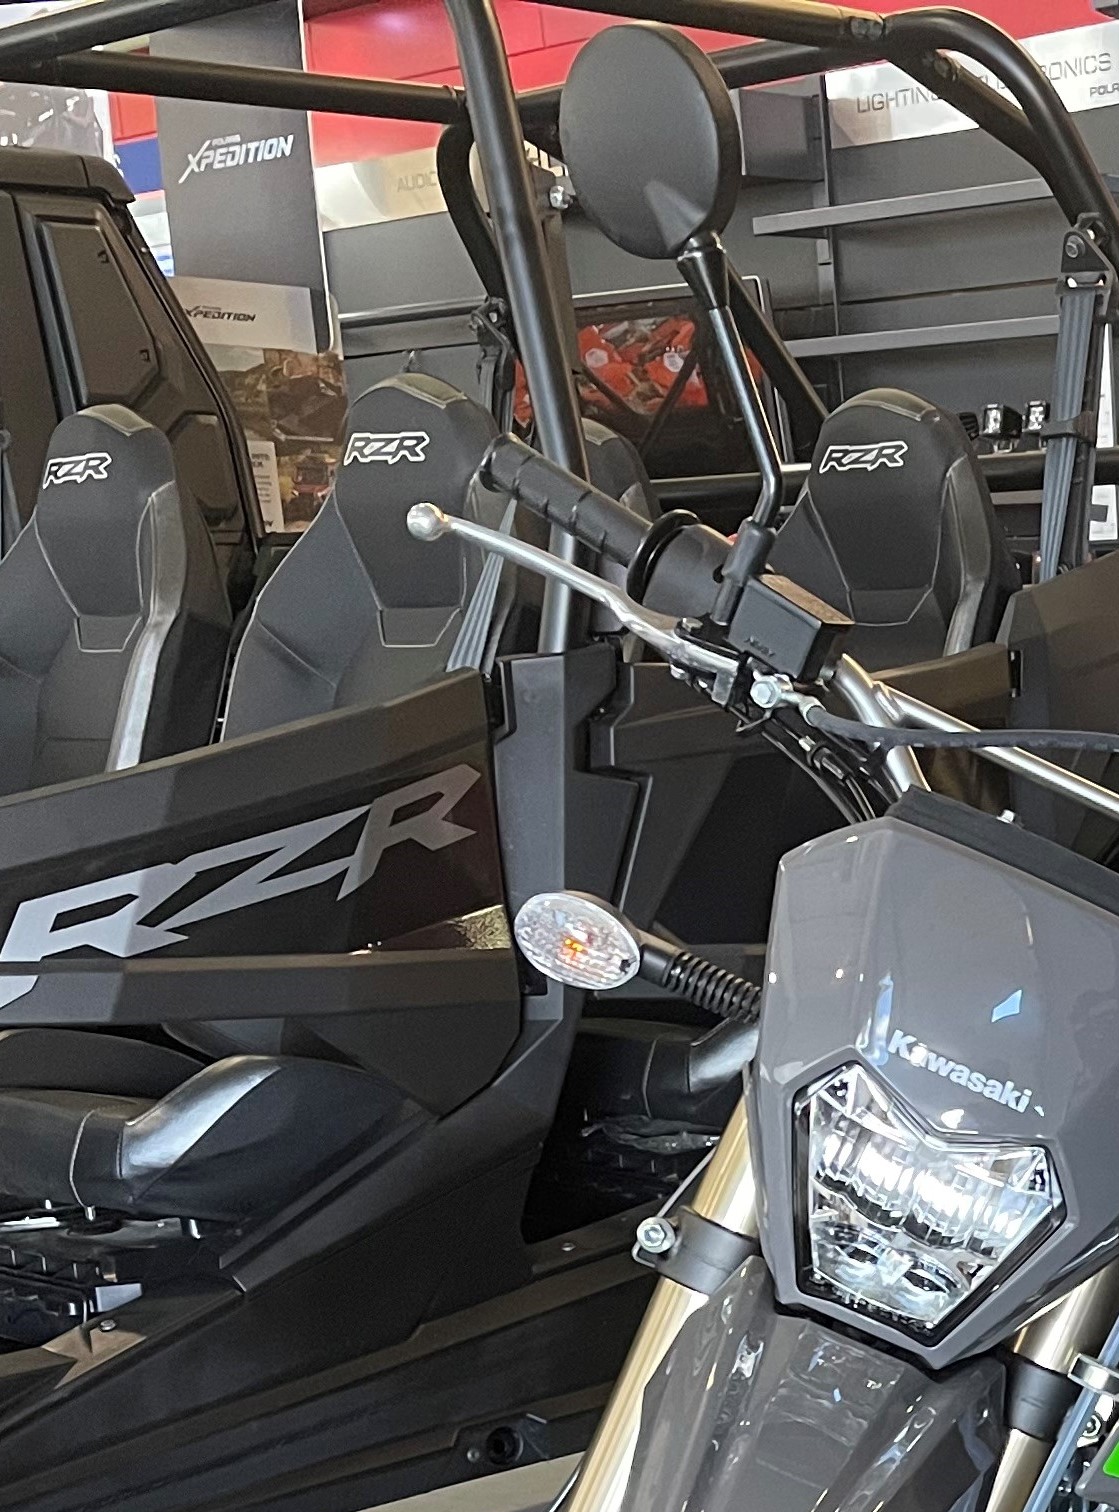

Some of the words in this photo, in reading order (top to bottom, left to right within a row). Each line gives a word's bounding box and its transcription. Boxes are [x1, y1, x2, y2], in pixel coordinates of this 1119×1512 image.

[178, 134, 294, 184] XPEDITION
[343, 431, 431, 466] RZR
[819, 440, 909, 474] RZR
[43, 452, 112, 490] RZR
[0, 763, 482, 1010] RZR
[887, 1029, 1033, 1114] Kawasaki
